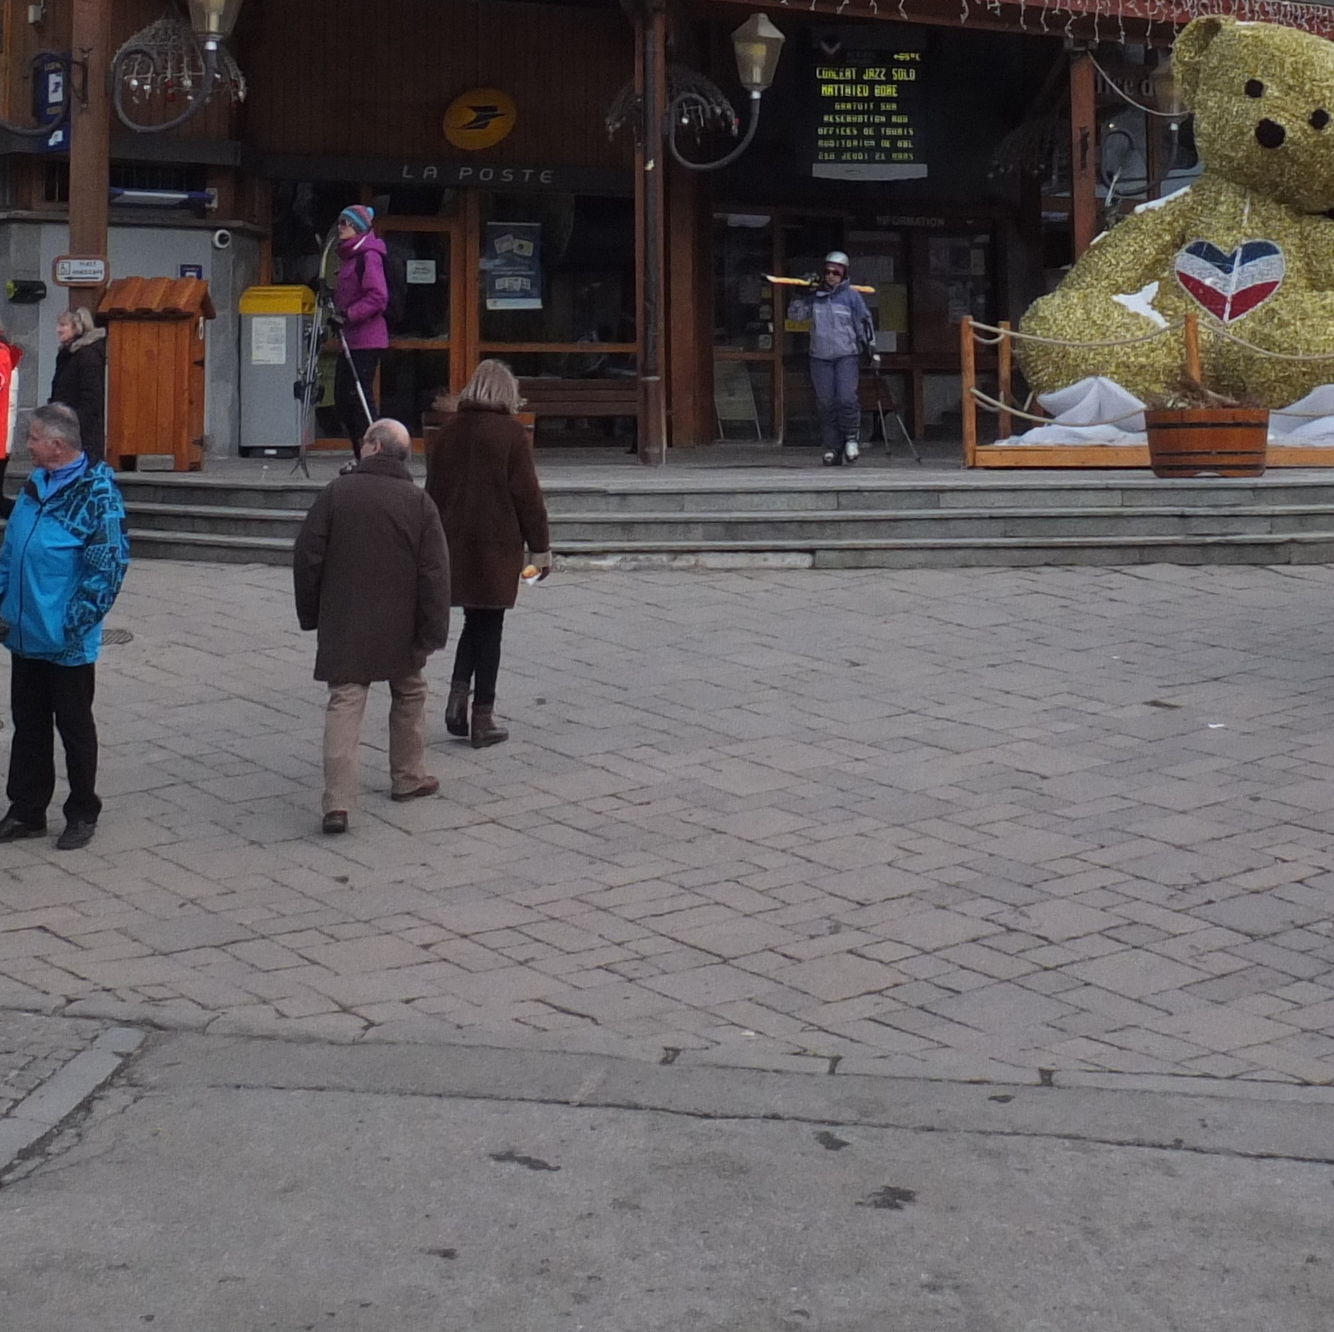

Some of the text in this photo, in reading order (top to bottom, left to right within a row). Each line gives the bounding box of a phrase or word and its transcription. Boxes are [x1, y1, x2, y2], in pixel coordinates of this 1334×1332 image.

[862, 67, 886, 81] JAZZ
[891, 68, 916, 81] SOLO
[821, 84, 869, 97] MATTHIEU
[1140, 76, 1155, 97] d
[402, 165, 555, 184] LA POSTE
[876, 215, 946, 227] INFORMATION
